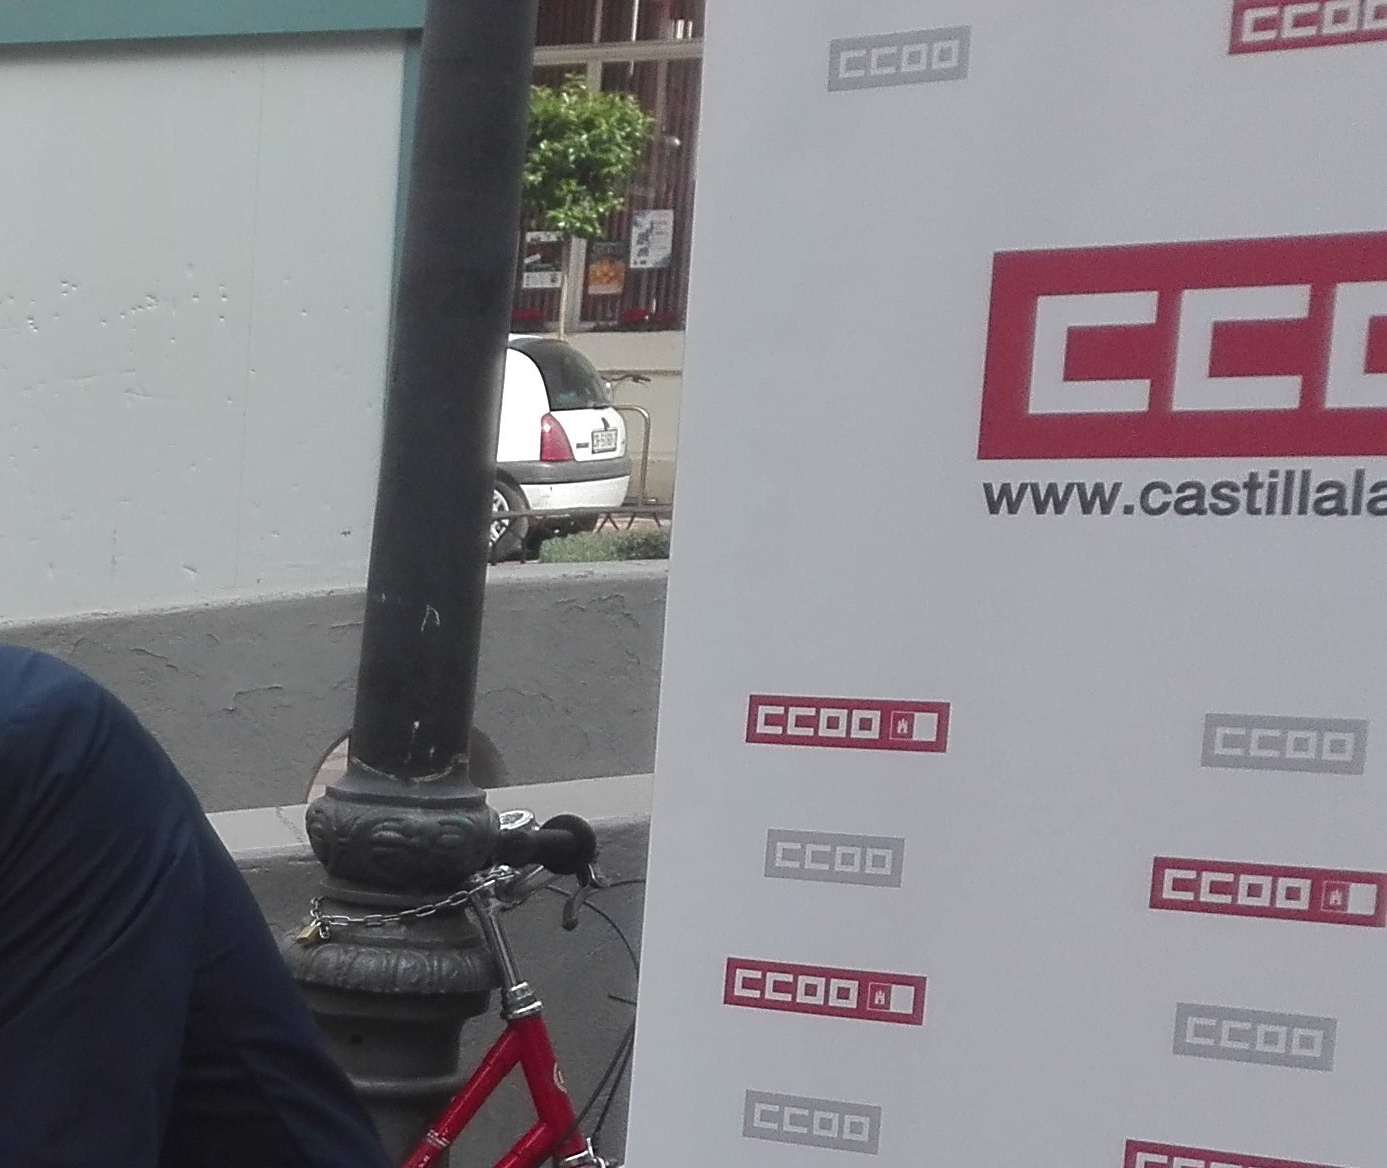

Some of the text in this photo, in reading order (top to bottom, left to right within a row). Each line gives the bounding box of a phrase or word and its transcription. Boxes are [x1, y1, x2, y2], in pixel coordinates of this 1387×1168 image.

[839, 40, 960, 78] CCOO
[756, 705, 881, 739] CCOO
[1214, 727, 1354, 762] CCOO
[774, 841, 894, 876] CCOO
[1161, 869, 1311, 908] CCOO
[734, 968, 859, 1008] CCOO
[1185, 1016, 1323, 1057] CCOO
[753, 1103, 870, 1142] CCOO
